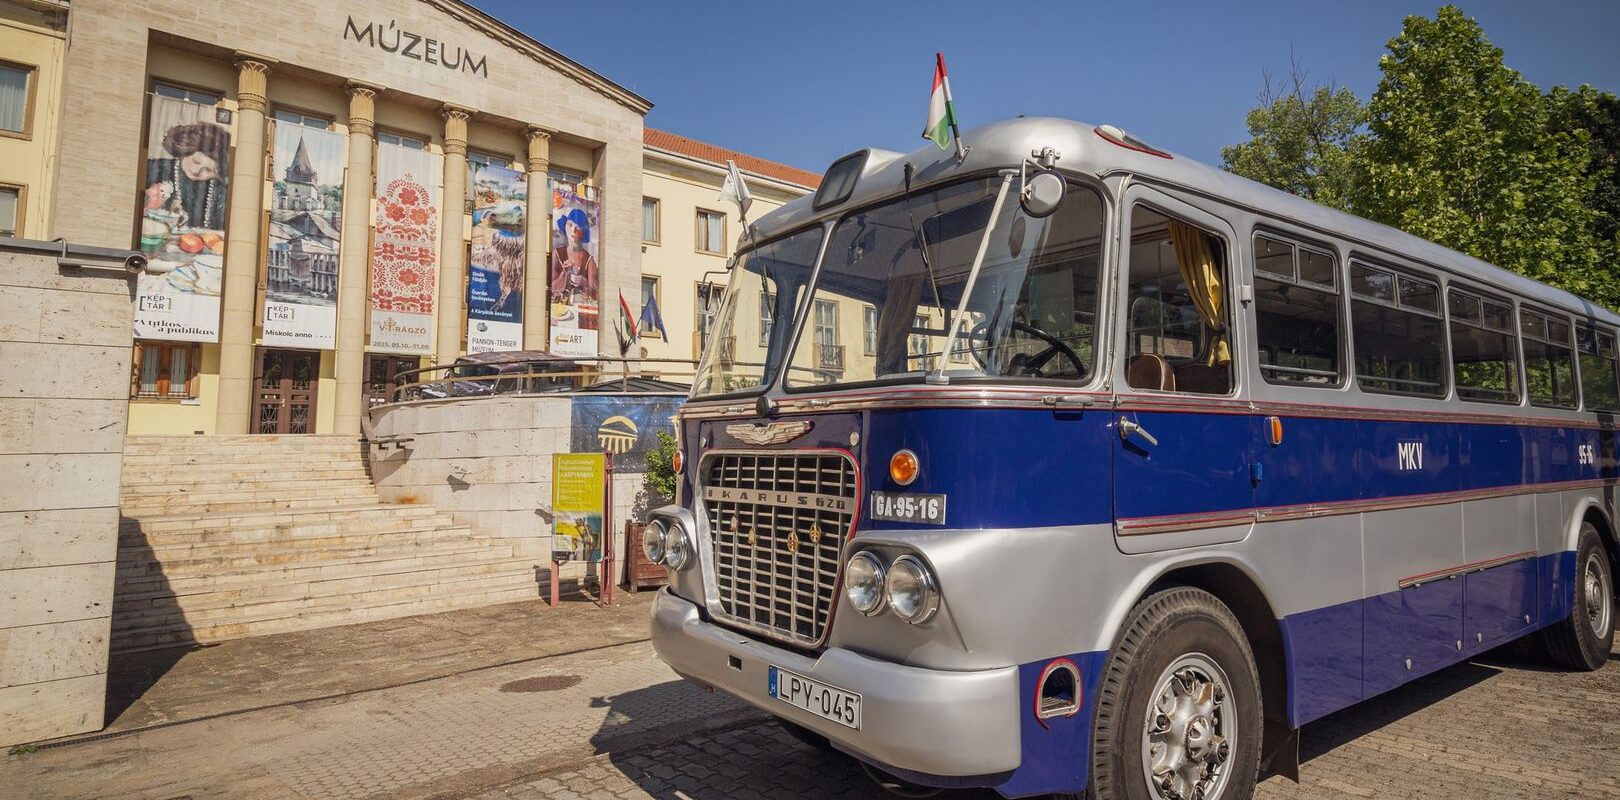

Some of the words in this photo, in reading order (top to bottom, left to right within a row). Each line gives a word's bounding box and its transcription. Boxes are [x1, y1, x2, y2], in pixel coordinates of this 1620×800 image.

[344, 14, 488, 79] MÚZEUM
[147, 293, 165, 302] KÉP
[167, 327, 215, 336] publikus
[265, 329, 294, 337] Miskolc
[294, 331, 313, 339] anno
[471, 337, 517, 348] PANNON-TENGER
[1398, 442, 1423, 470] MKV
[707, 488, 809, 506] IKARUS
[876, 495, 939, 520] GA-95-16
[770, 683, 776, 693] H
[780, 673, 855, 724] LPY-045
